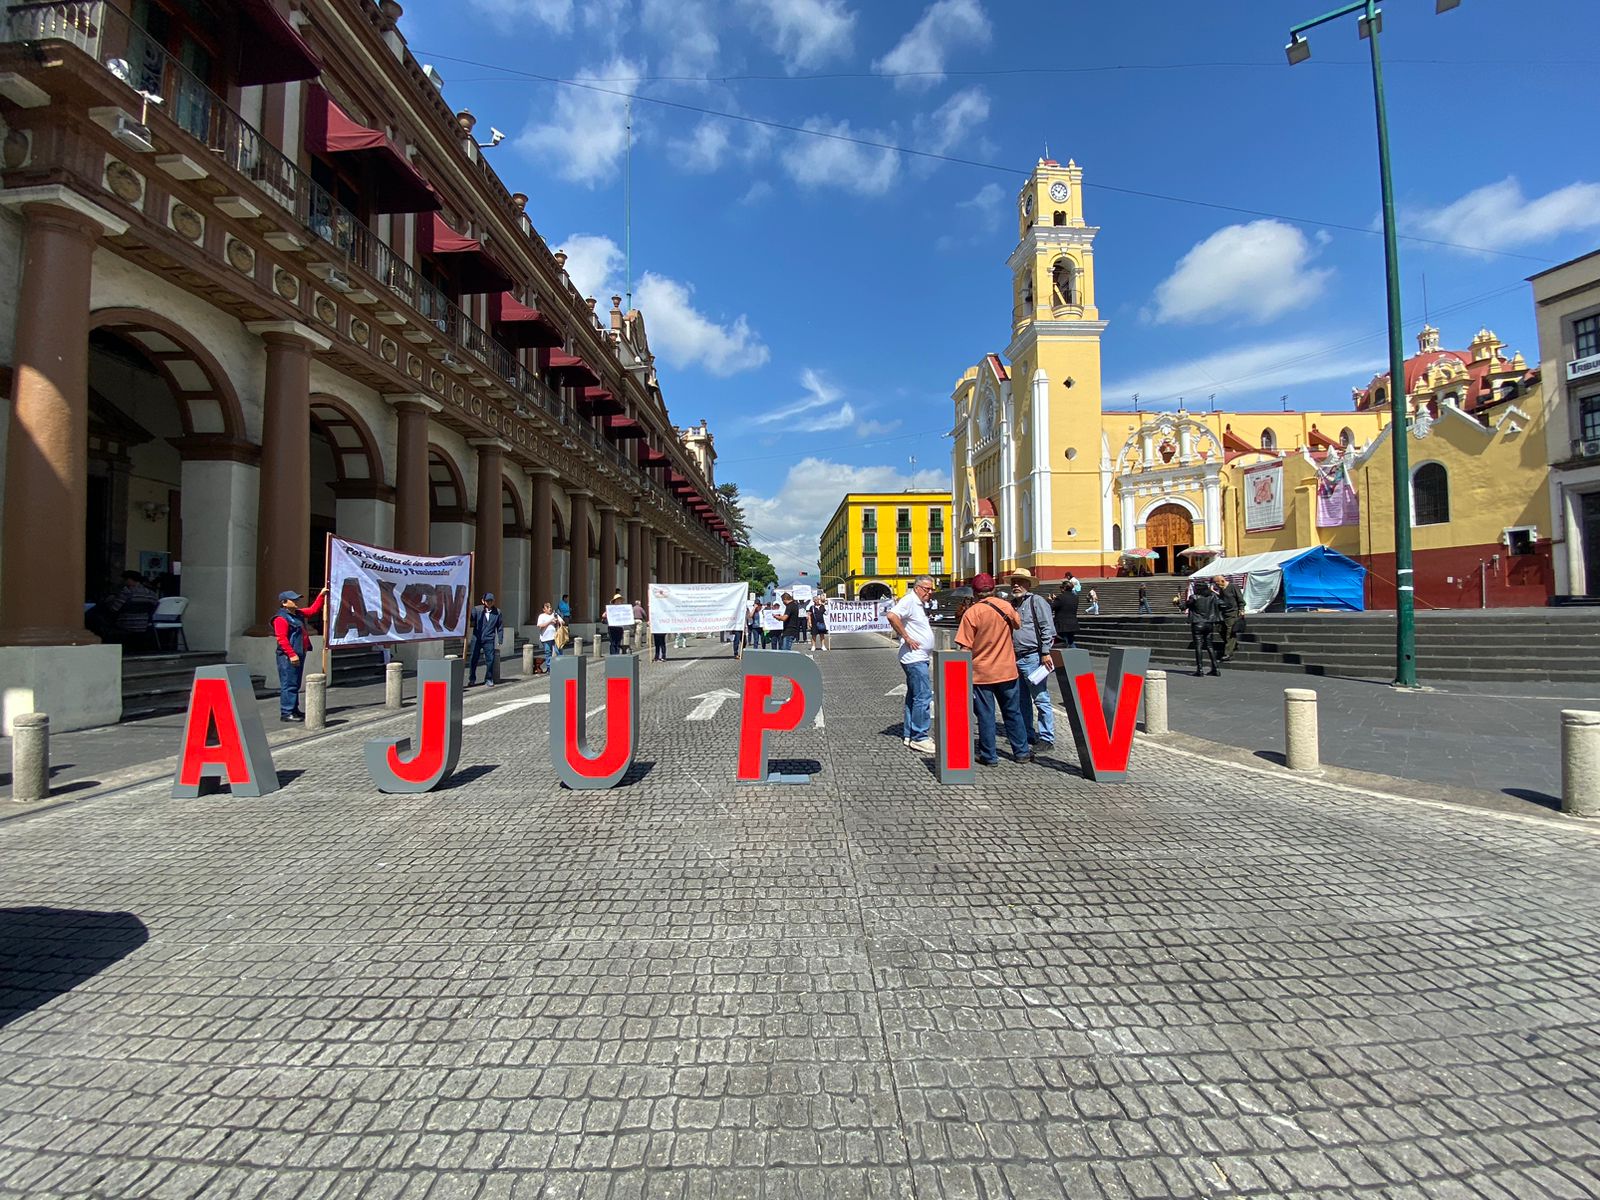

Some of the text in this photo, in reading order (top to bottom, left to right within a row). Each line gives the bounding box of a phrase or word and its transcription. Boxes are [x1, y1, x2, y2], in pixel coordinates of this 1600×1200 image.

[360, 560, 402, 574] Jubilados
[829, 602, 872, 610] YA BASTA DE
[829, 612, 873, 622] MENTIRAS
